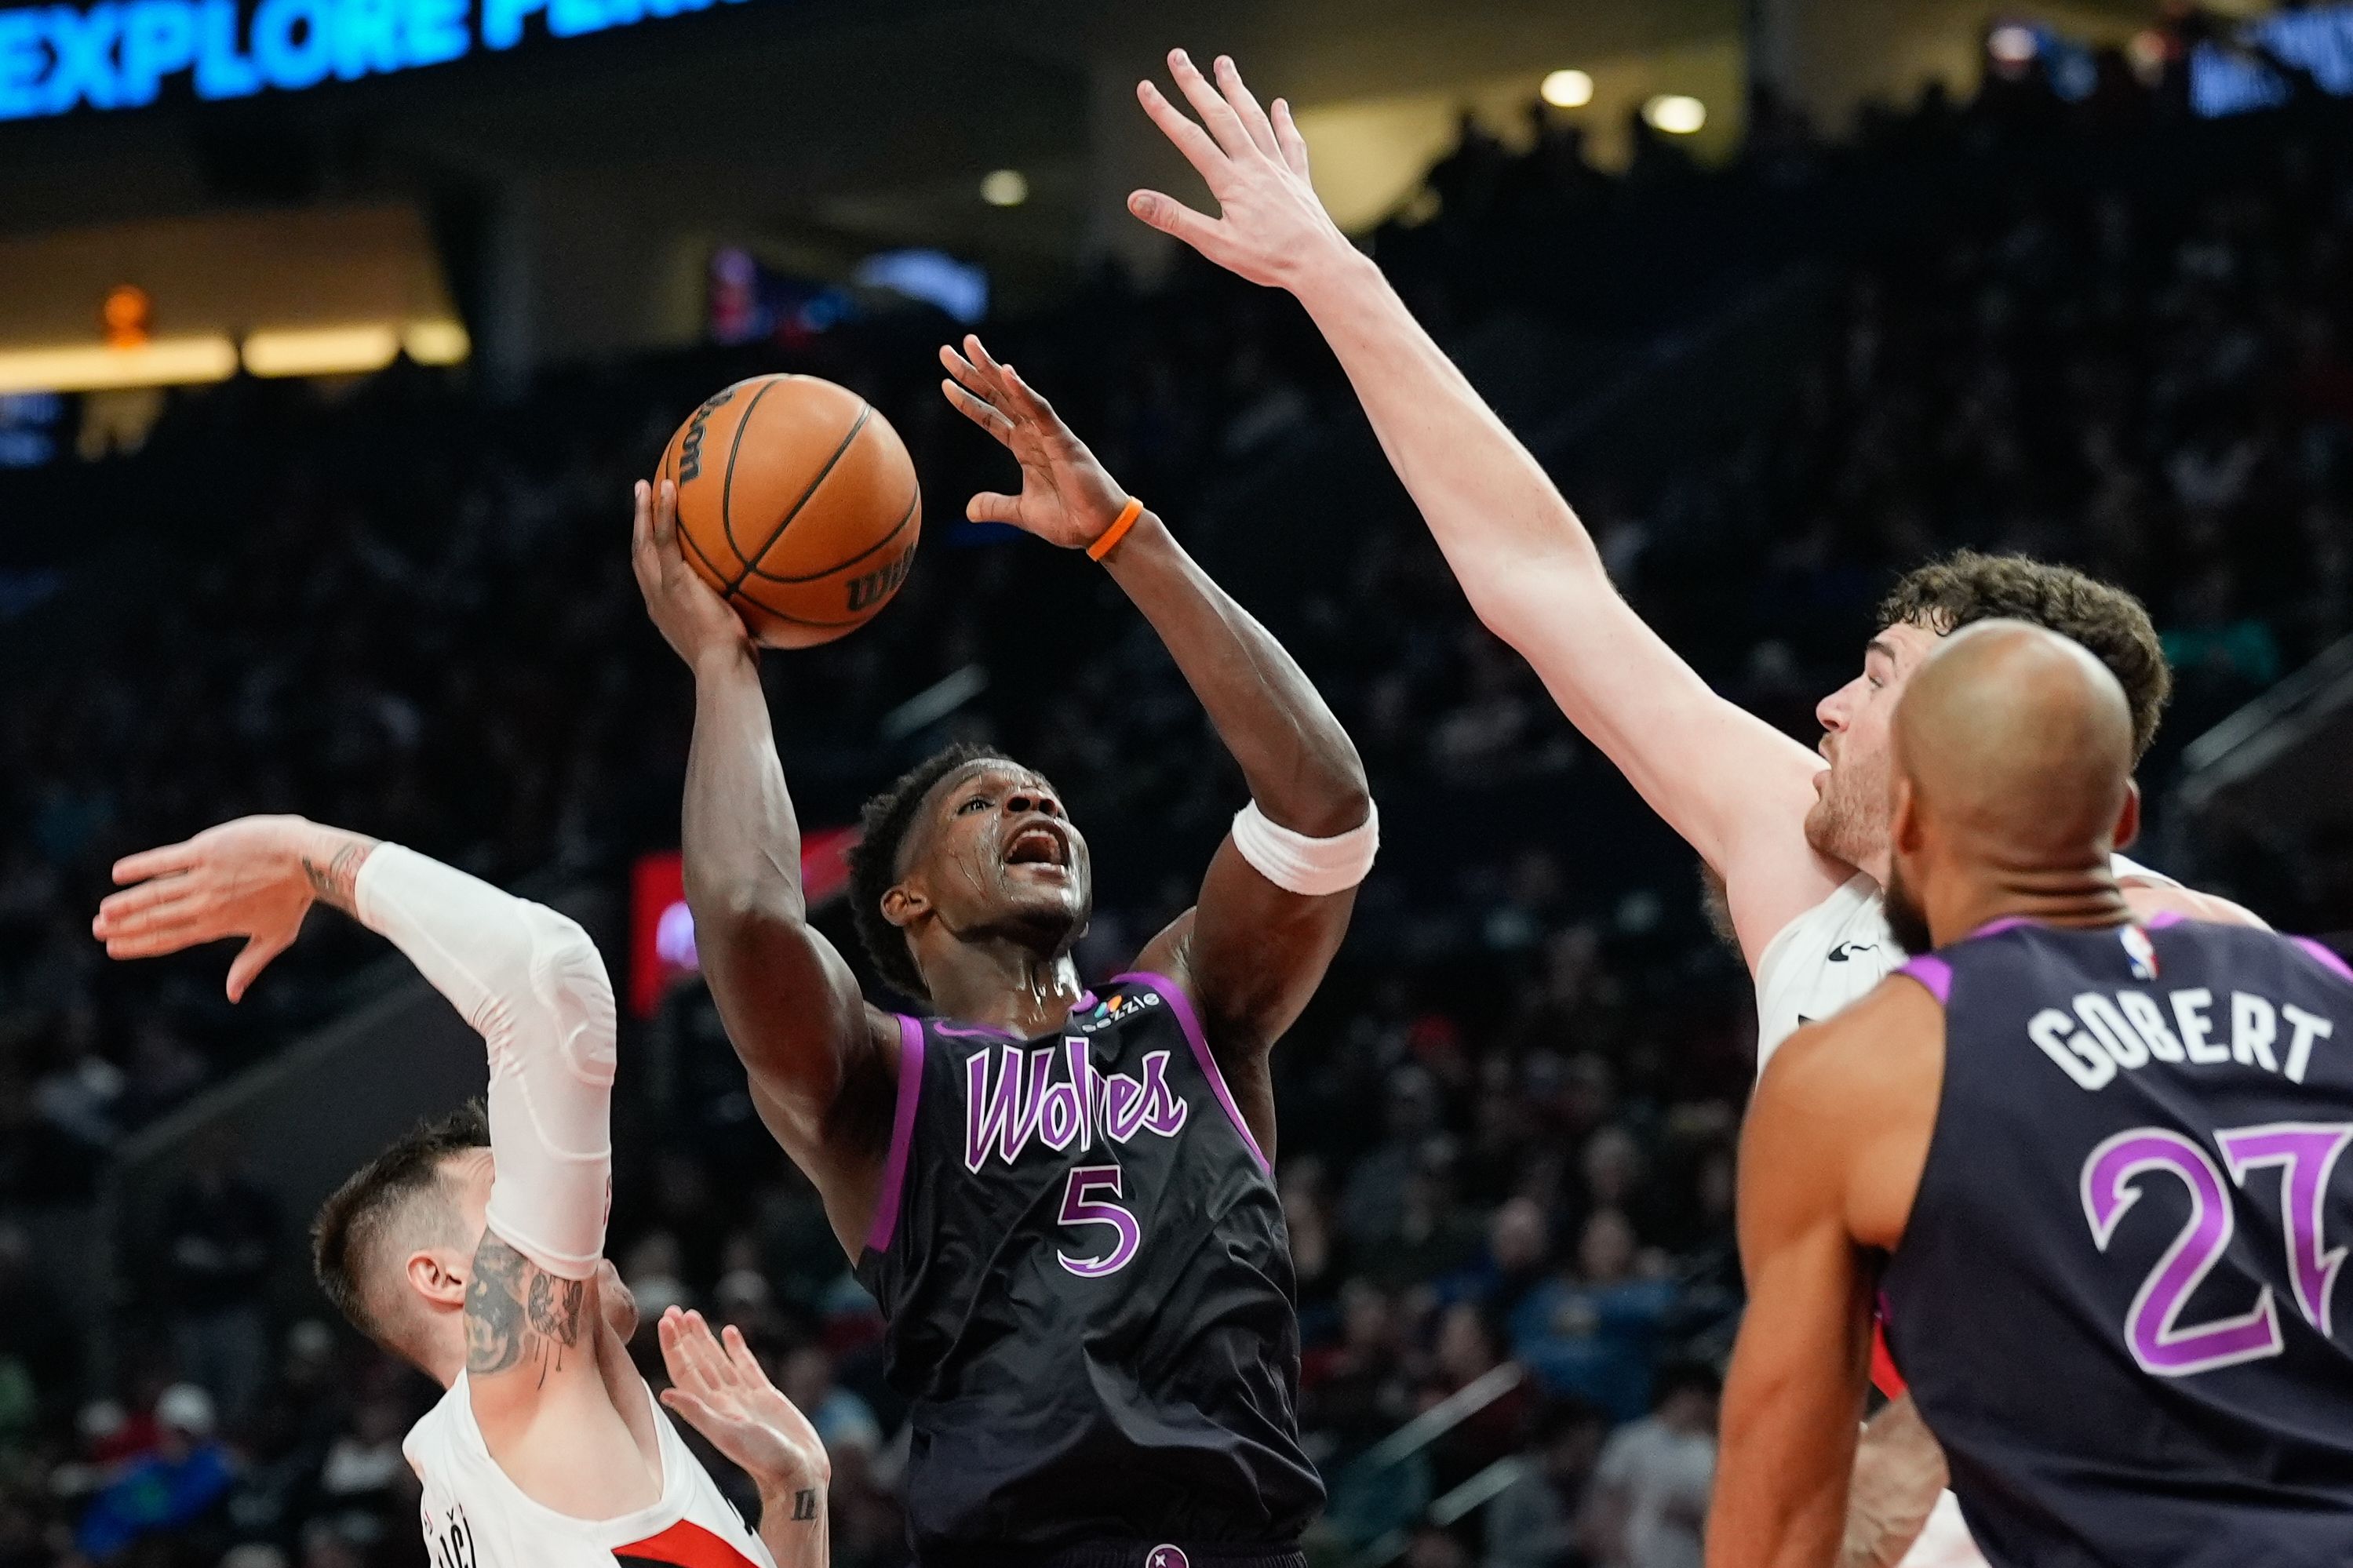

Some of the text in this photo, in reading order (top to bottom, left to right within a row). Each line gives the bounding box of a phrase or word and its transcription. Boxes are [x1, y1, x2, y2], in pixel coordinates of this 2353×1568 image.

[0, 0, 471, 120] EXPLORE
[2028, 988, 2333, 1092] GOBERT
[1057, 1165, 1141, 1279] 5
[2080, 1122, 2353, 1377] 27
